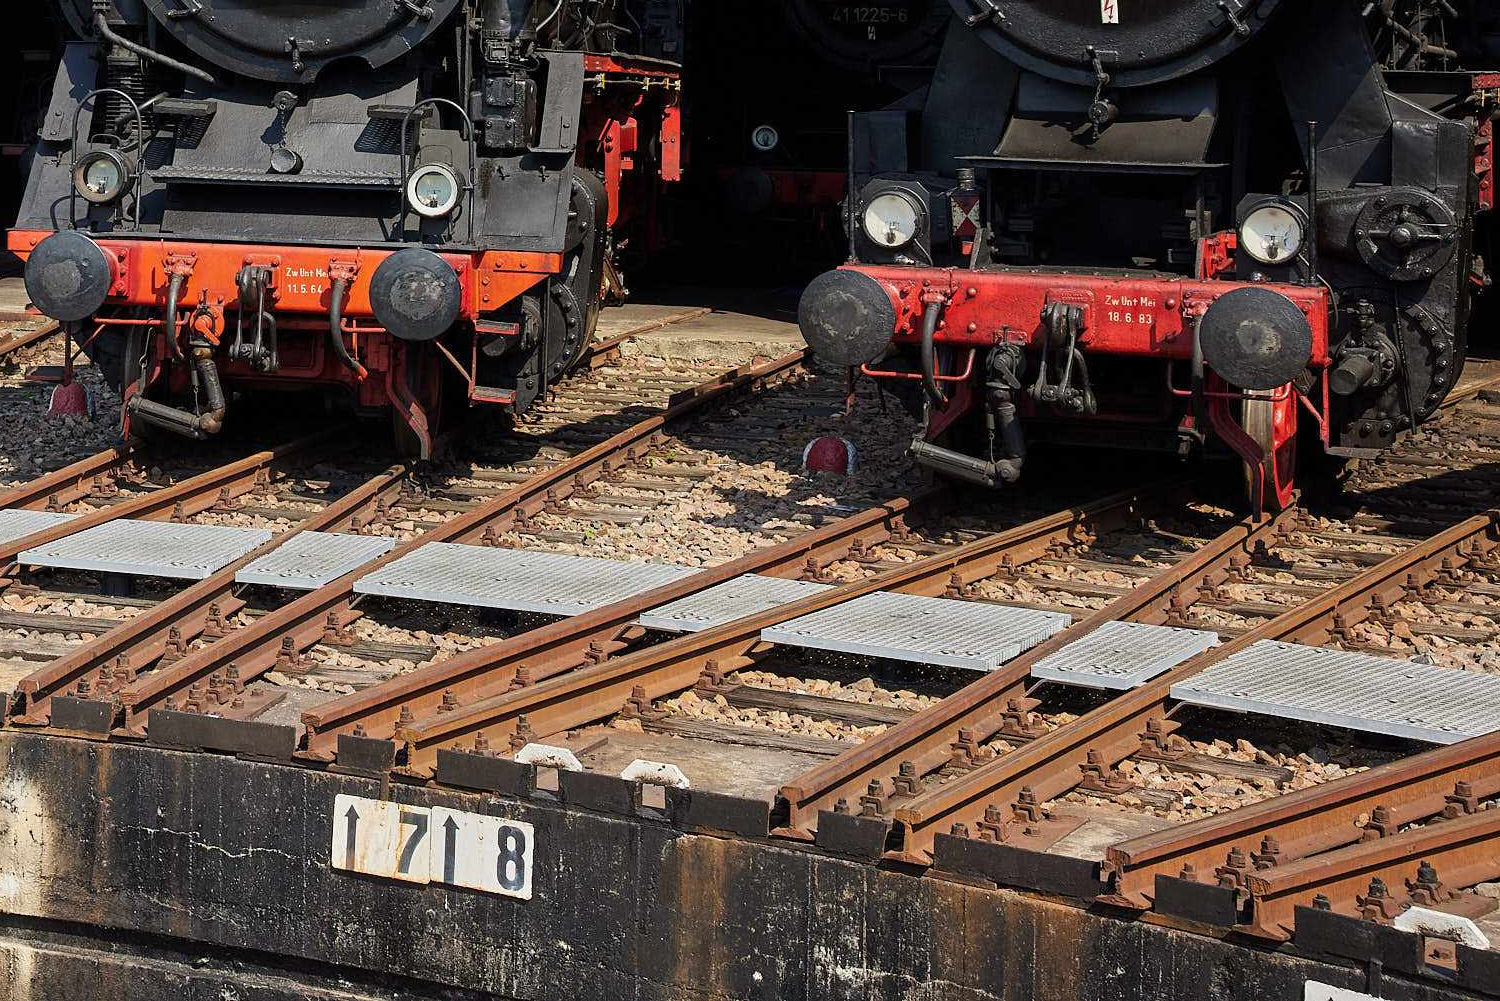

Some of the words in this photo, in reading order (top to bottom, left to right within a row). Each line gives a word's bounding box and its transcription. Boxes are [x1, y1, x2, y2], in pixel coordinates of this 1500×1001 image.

[1105, 295, 1120, 306] Zw
[1121, 296, 1138, 306] Unt
[1140, 297, 1156, 307] Mei
[397, 811, 429, 874] 7
[496, 825, 526, 892] 8
